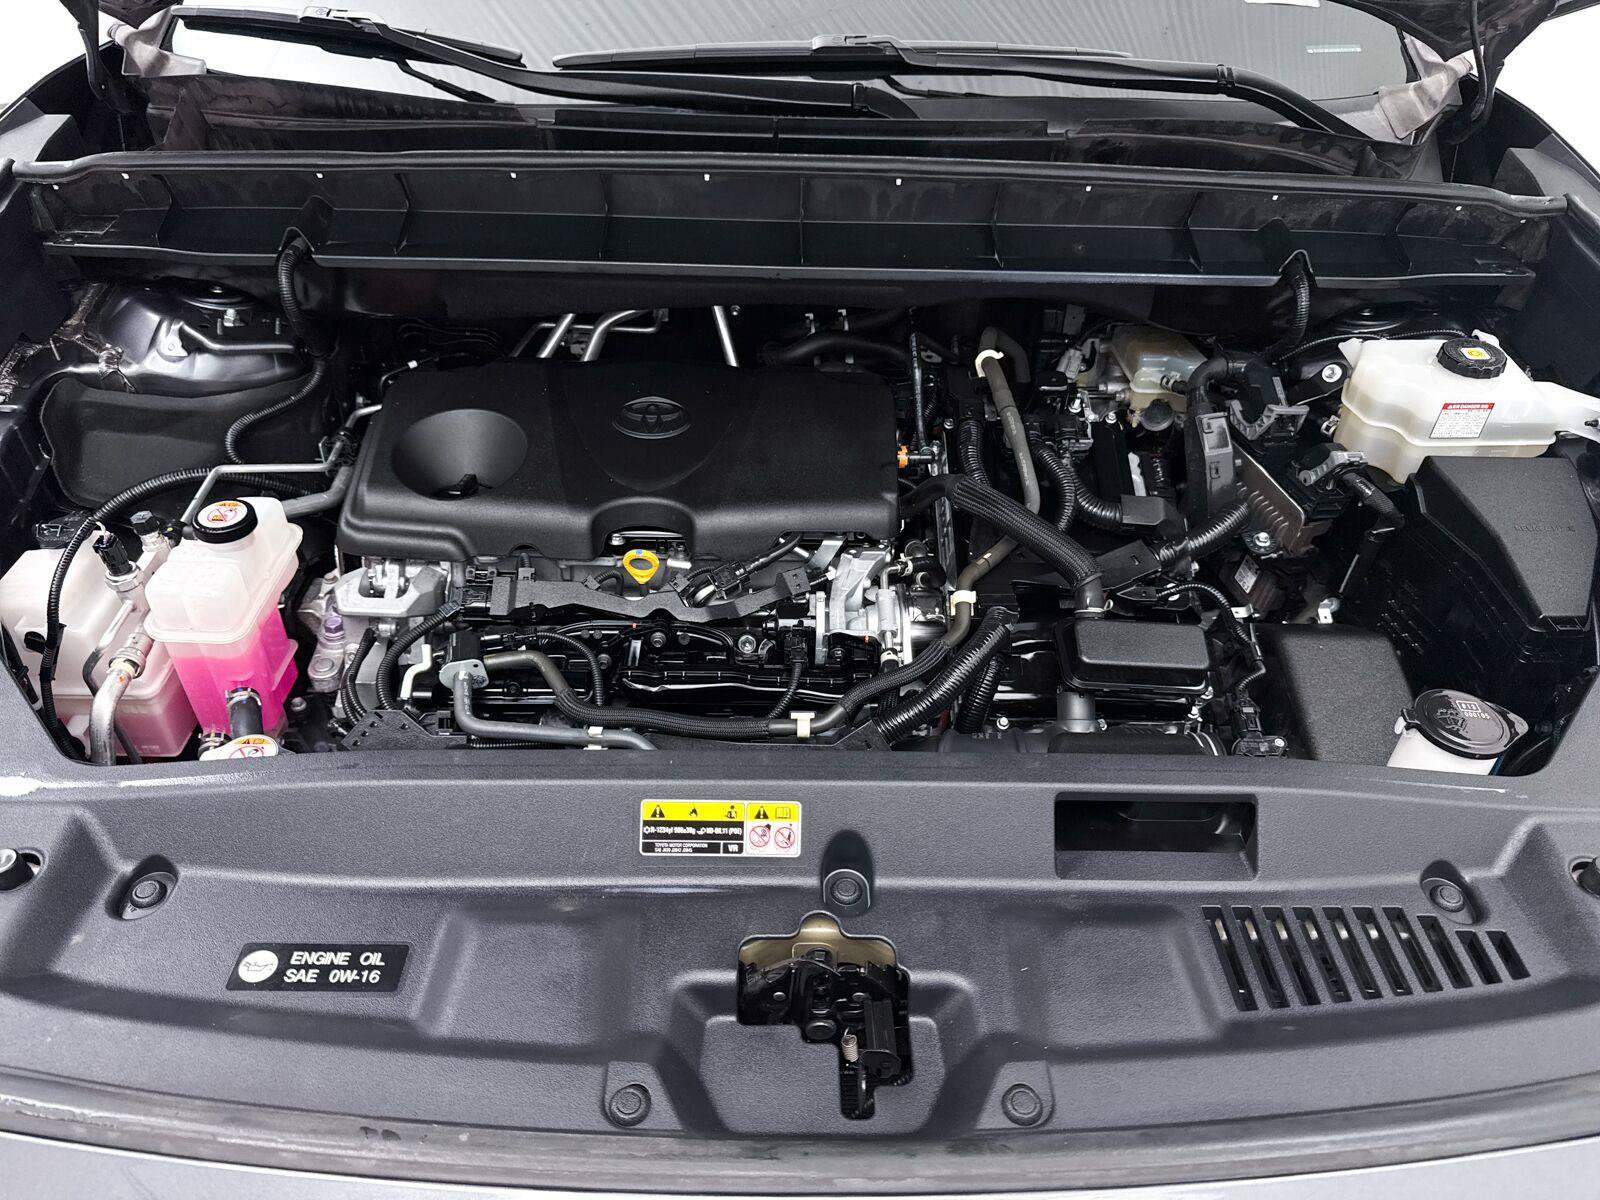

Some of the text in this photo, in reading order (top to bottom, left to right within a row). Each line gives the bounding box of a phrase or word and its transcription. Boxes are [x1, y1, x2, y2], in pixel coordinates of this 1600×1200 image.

[290, 951, 386, 966] ENGINE OIL
[284, 969, 382, 984] SAE 0W-16
